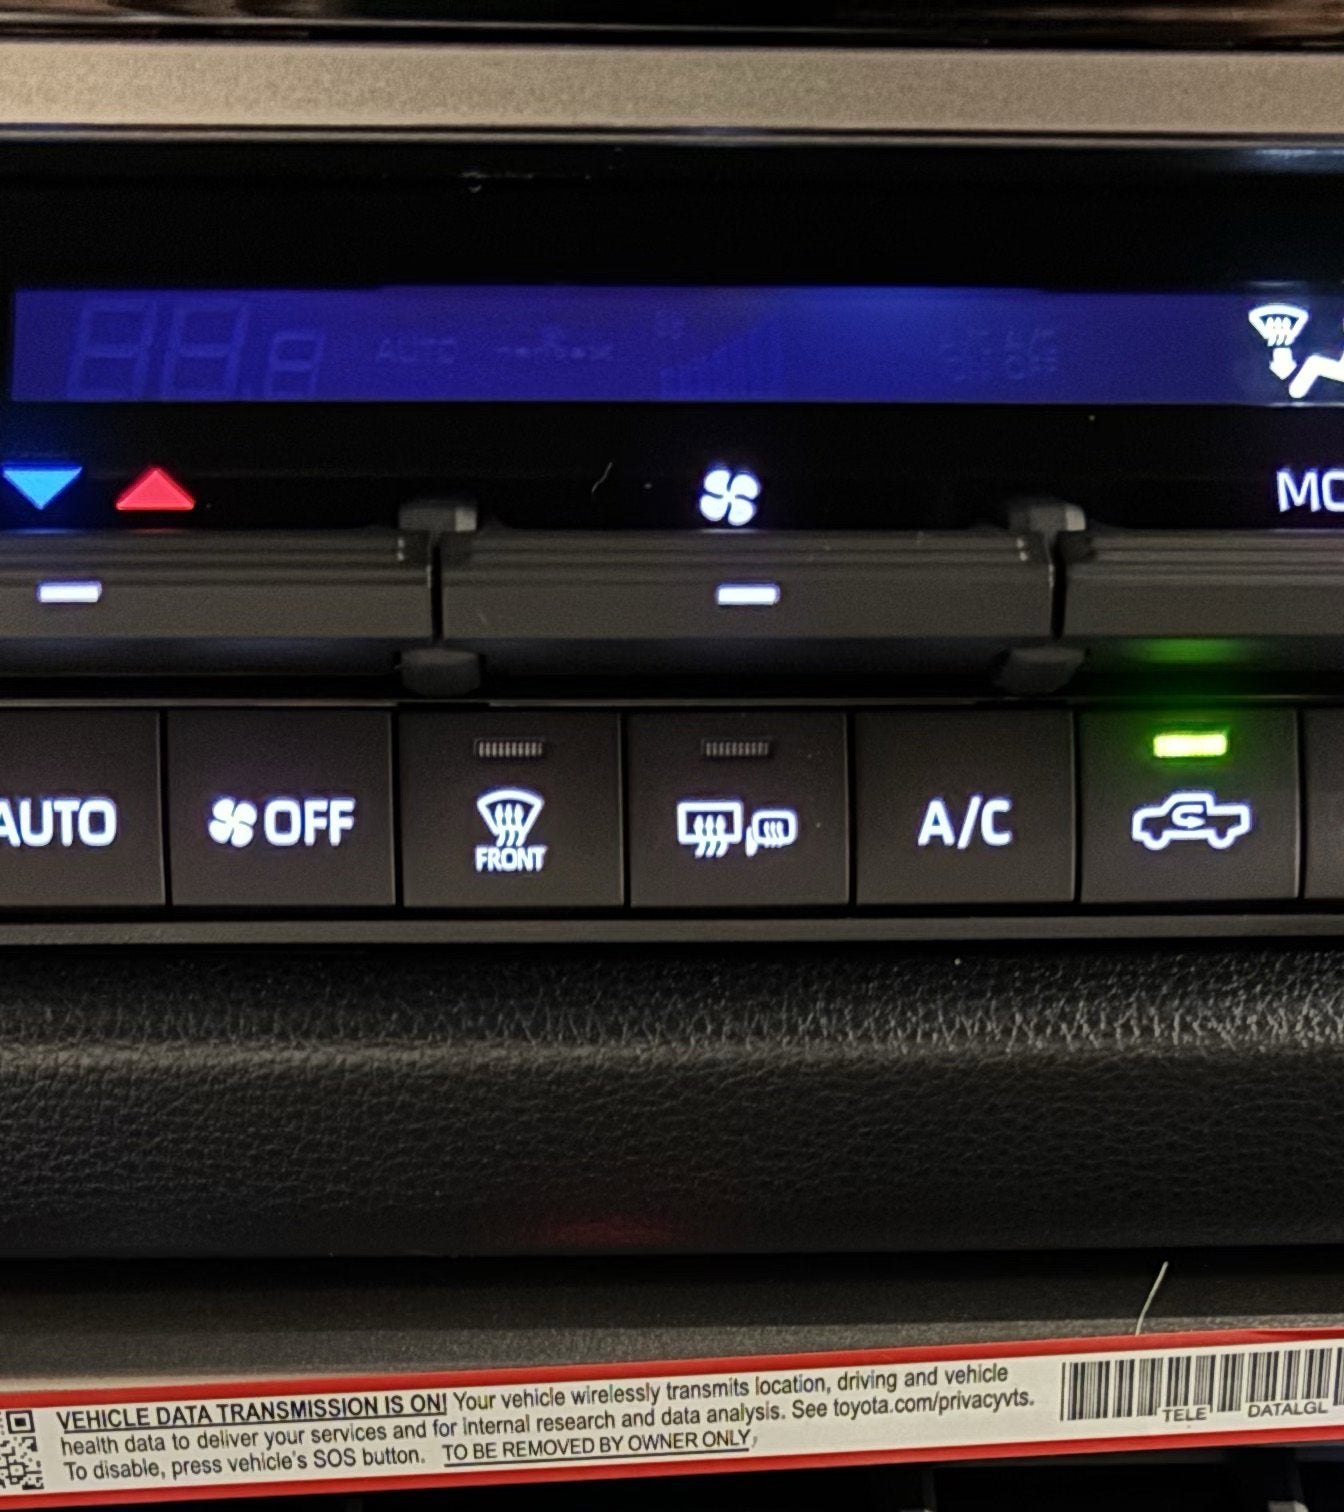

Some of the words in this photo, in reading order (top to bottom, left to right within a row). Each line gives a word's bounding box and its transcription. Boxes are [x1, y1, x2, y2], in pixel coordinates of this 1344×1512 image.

[263, 798, 355, 847] OFF
[917, 797, 1013, 849] A/C
[475, 845, 546, 872] FRONT
[57, 1407, 151, 1429] VEHICLE
[157, 1404, 213, 1425] DATA
[217, 1397, 380, 1423] TRANSMISSION
[386, 1396, 405, 1416] IS
[455, 1392, 498, 1413] Your
[502, 1388, 567, 1410] vehicle
[572, 1384, 663, 1411] wirelessly
[667, 1379, 751, 1402] transmits
[756, 1375, 832, 1401] location,
[838, 1371, 899, 1397] driving
[904, 1369, 940, 1390] and
[946, 1364, 1010, 1387] vehicle
[1162, 1407, 1207, 1423] TELE
[1248, 1402, 1328, 1418] DATALGL
[62, 1435, 120, 1456] health
[125, 1433, 167, 1454] data
[173, 1432, 191, 1451] to
[197, 1428, 261, 1450] deliver
[265, 1426, 307, 1451] your
[311, 1422, 388, 1445] services
[393, 1420, 428, 1441] and
[433, 1419, 459, 1439] for
[464, 1415, 532, 1437] internal
[537, 1411, 617, 1434] research
[622, 1408, 657, 1429] and
[662, 1406, 702, 1427] data
[707, 1402, 786, 1428] analysis.
[792, 1399, 829, 1420] See
[834, 1388, 1035, 1421] toyota.com/privacyvts.
[65, 1462, 89, 1482] To
[94, 1458, 166, 1484] disable,
[172, 1456, 224, 1480] press
[228, 1451, 309, 1474] vehicle's
[314, 1449, 358, 1469] SOS
[363, 1445, 426, 1467] button.
[443, 1443, 469, 1463] TO
[474, 1442, 498, 1461] BE
[503, 1436, 596, 1460] REMOVED
[600, 1435, 626, 1455] BY
[628, 1431, 700, 1453] OWNER
